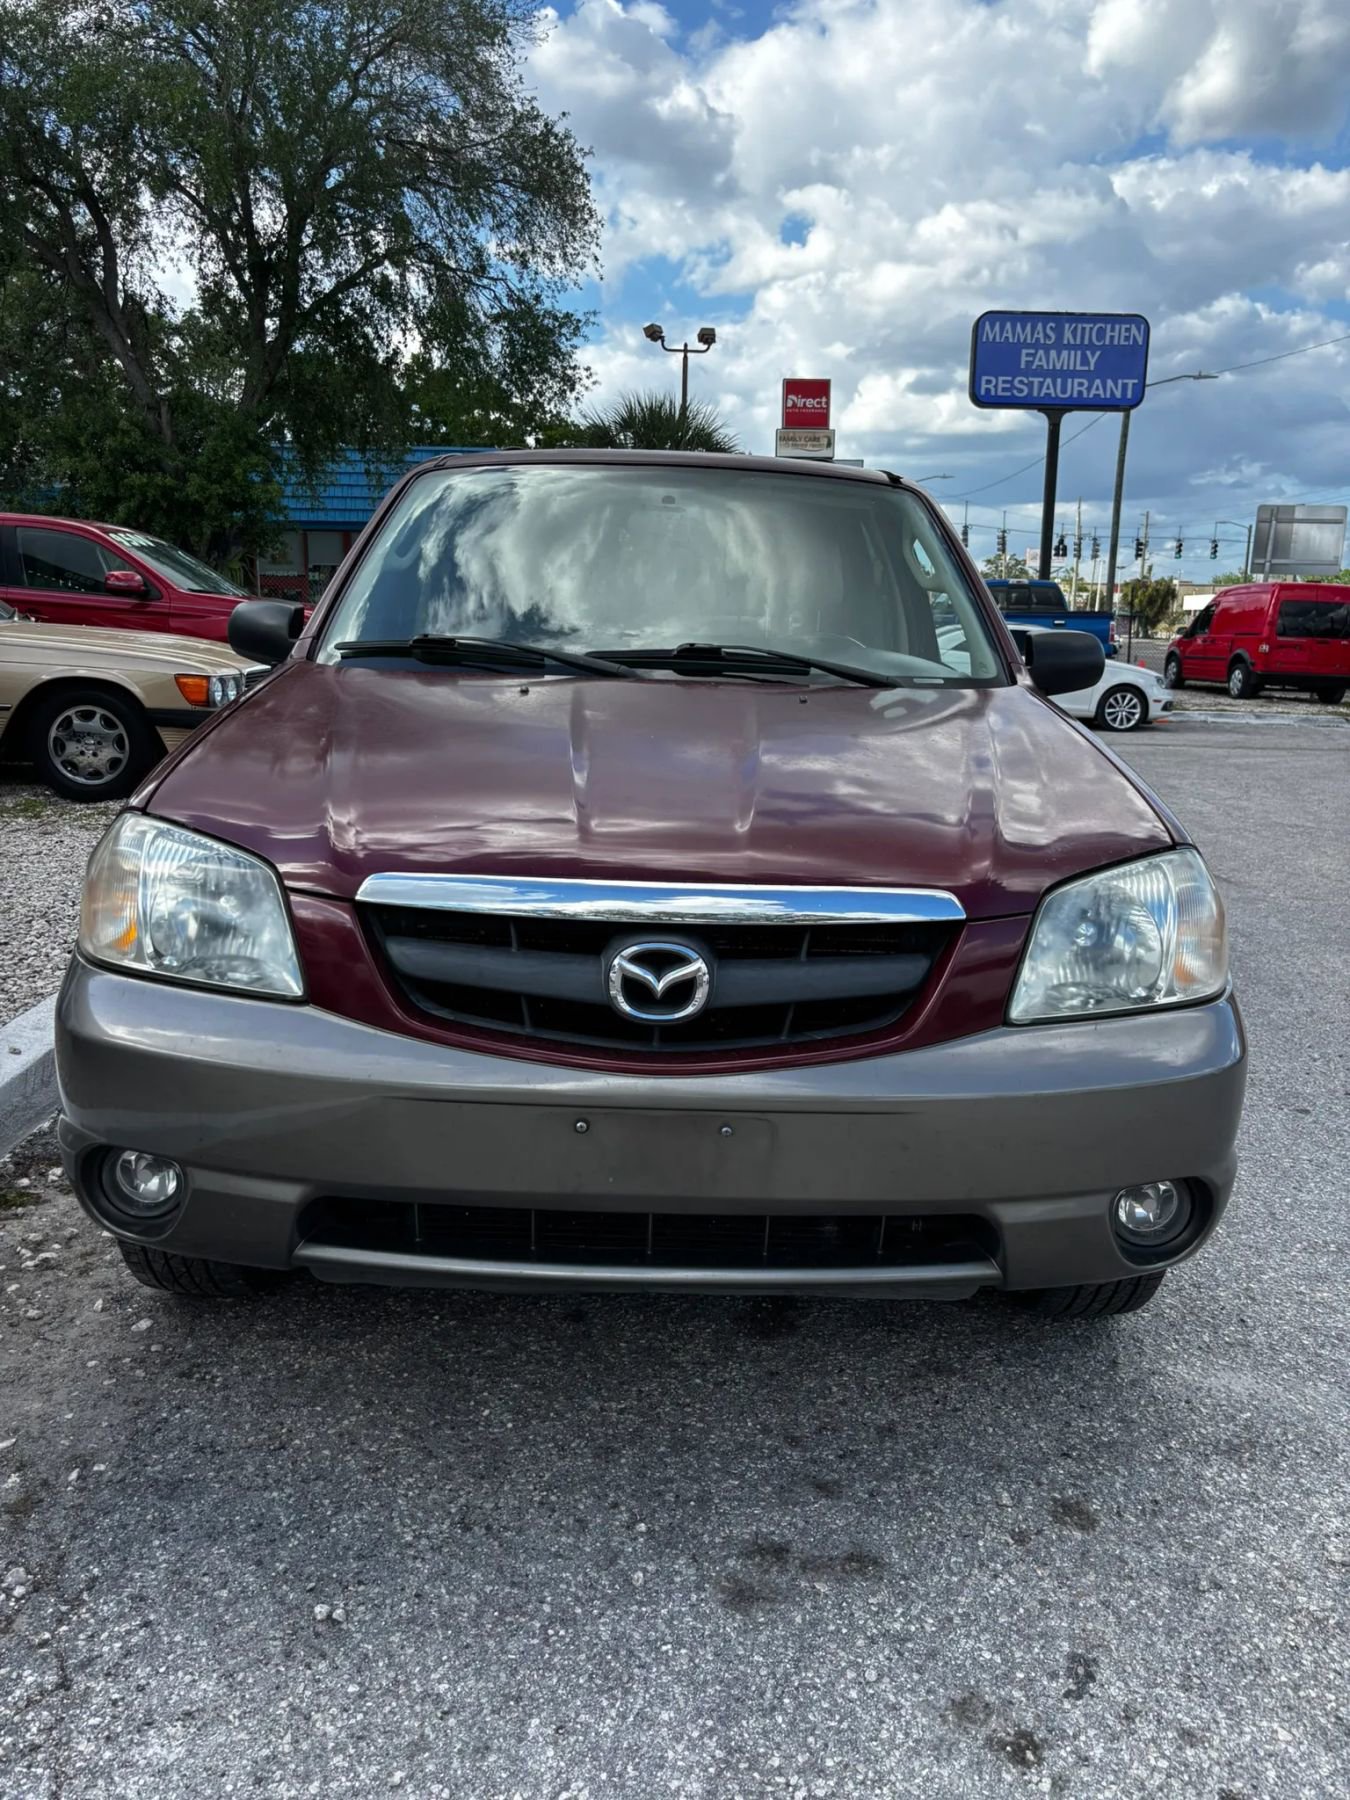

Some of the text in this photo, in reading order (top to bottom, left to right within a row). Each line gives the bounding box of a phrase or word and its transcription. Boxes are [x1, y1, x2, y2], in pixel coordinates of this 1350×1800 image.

[982, 321, 1144, 346] MAMAS KITCHEN
[1020, 349, 1102, 371] FAMILY
[980, 376, 1138, 399] RESTAURANT
[786, 394, 828, 408] Direct
